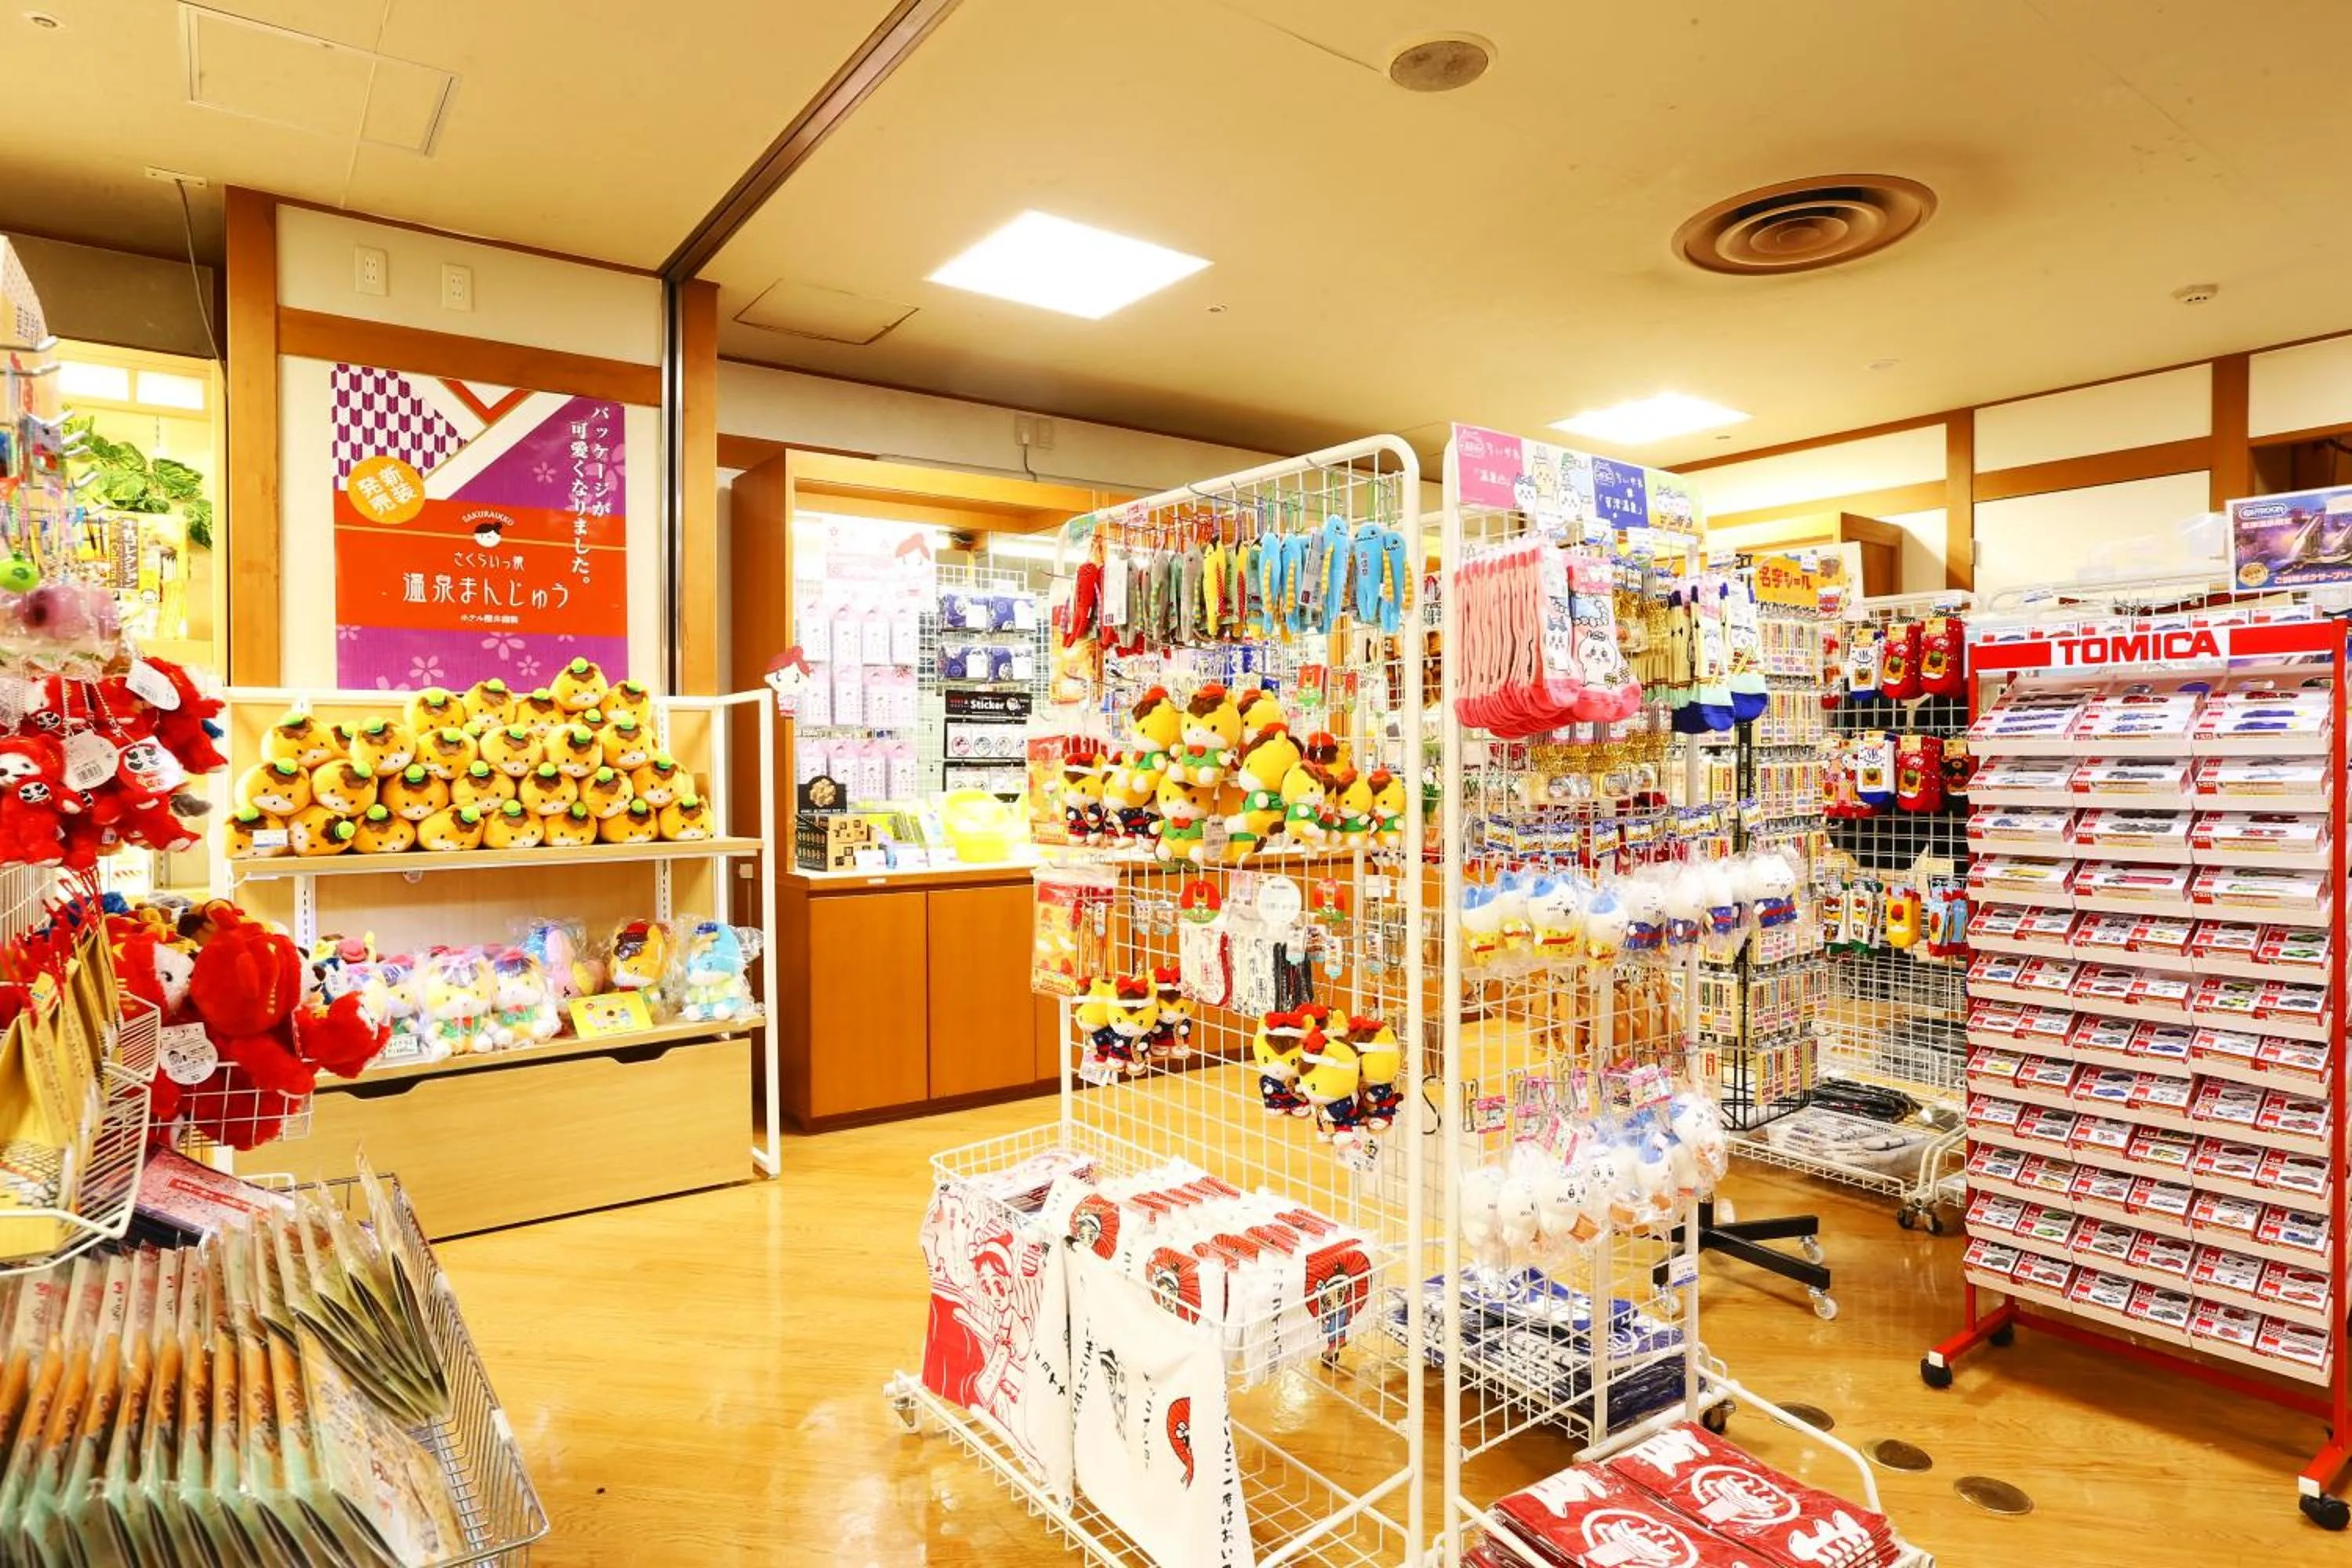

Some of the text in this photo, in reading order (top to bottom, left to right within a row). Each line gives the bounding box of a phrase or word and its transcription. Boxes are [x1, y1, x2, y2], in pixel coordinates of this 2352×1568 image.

[592, 406, 612, 517] パッケージが
[570, 421, 590, 585] 可愛くなりました。
[402, 572, 570, 609] 温泉まんじゅう
[1759, 565, 1812, 590] 名字シール
[2058, 629, 2222, 666] TOMICA
[970, 699, 1005, 710] Sticker
